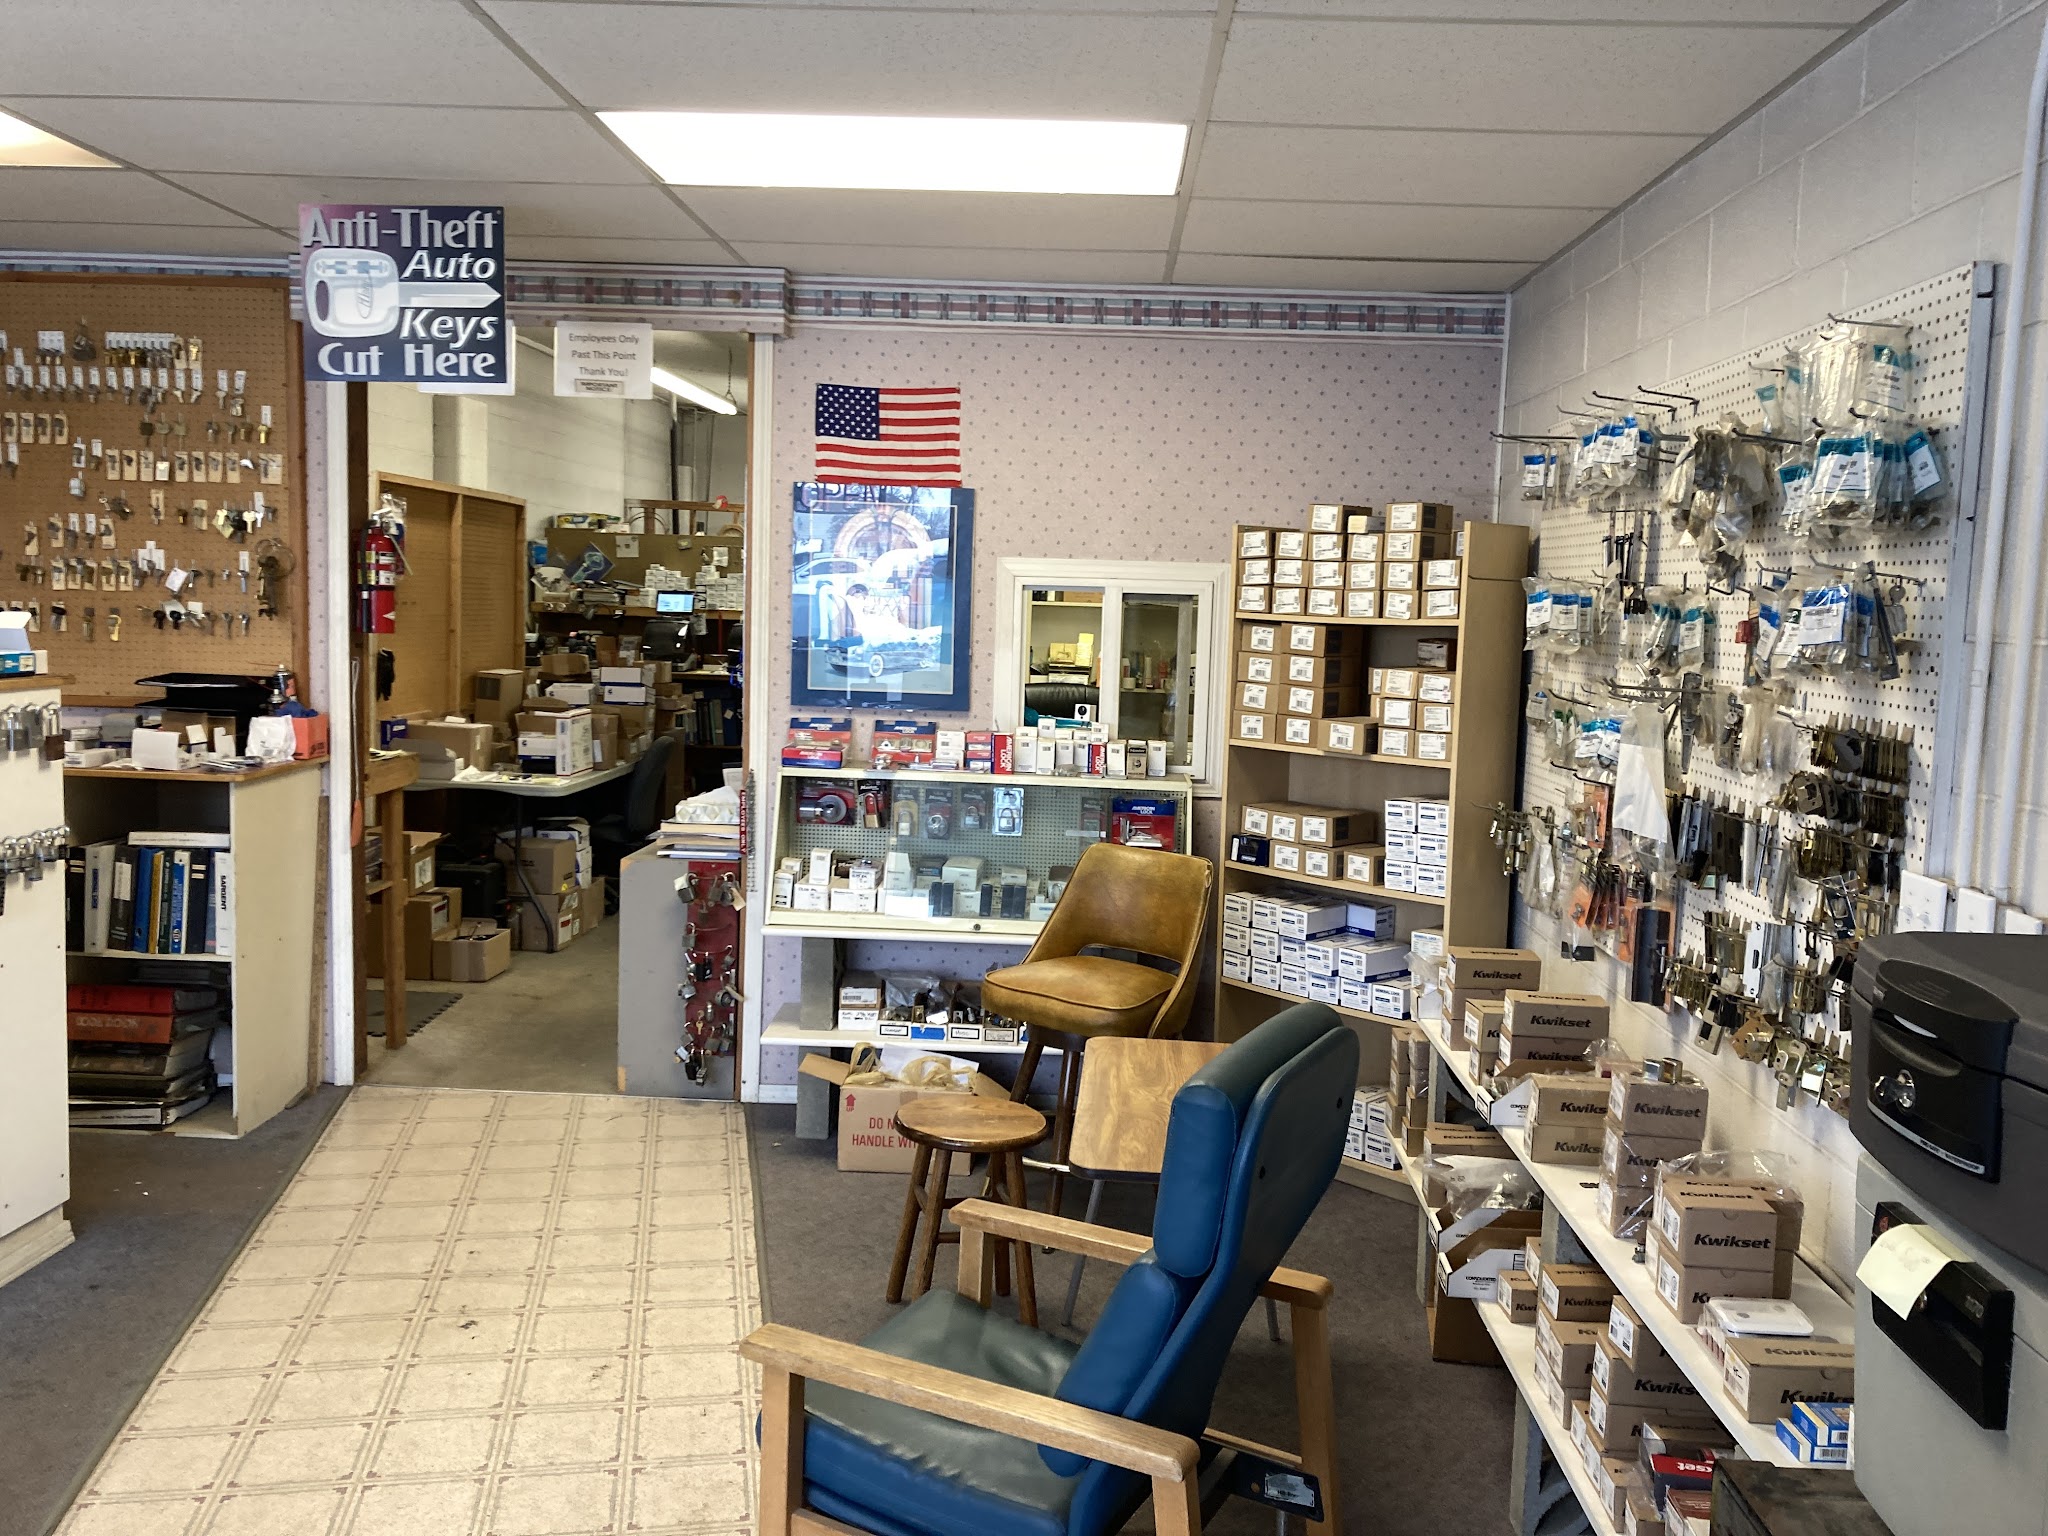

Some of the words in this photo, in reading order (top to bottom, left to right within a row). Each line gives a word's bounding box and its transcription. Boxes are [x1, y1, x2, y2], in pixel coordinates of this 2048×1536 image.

[303, 207, 498, 249] Anti-Theft
[401, 249, 497, 280] Auto
[400, 308, 498, 349] Keys
[569, 333, 617, 344] Employees
[619, 334, 640, 345] Only
[318, 342, 384, 377] Cut
[405, 344, 496, 378] Here
[571, 350, 591, 359] Past
[593, 350, 611, 360] This
[613, 351, 636, 360] Point
[579, 366, 606, 376] Thank
[608, 367, 628, 377] You!
[1472, 970, 1523, 980] Kwikset
[1530, 1015, 1592, 1028] Kwikset
[1560, 1102, 1608, 1114] Kwiks
[1633, 1102, 1701, 1118] Kwikset
[869, 1117, 883, 1130] DO
[852, 1134, 895, 1148] HANDLE
[1368, 1136, 1381, 1144] GENERAL
[1554, 1142, 1600, 1154] Kwiks
[1680, 1191, 1754, 1199] Kwikset
[1694, 1234, 1772, 1249] Kwikset
[1564, 1298, 1612, 1307] Kwikse
[1765, 1348, 1854, 1358] Kwikse
[1634, 1379, 1701, 1395] Kwiks
